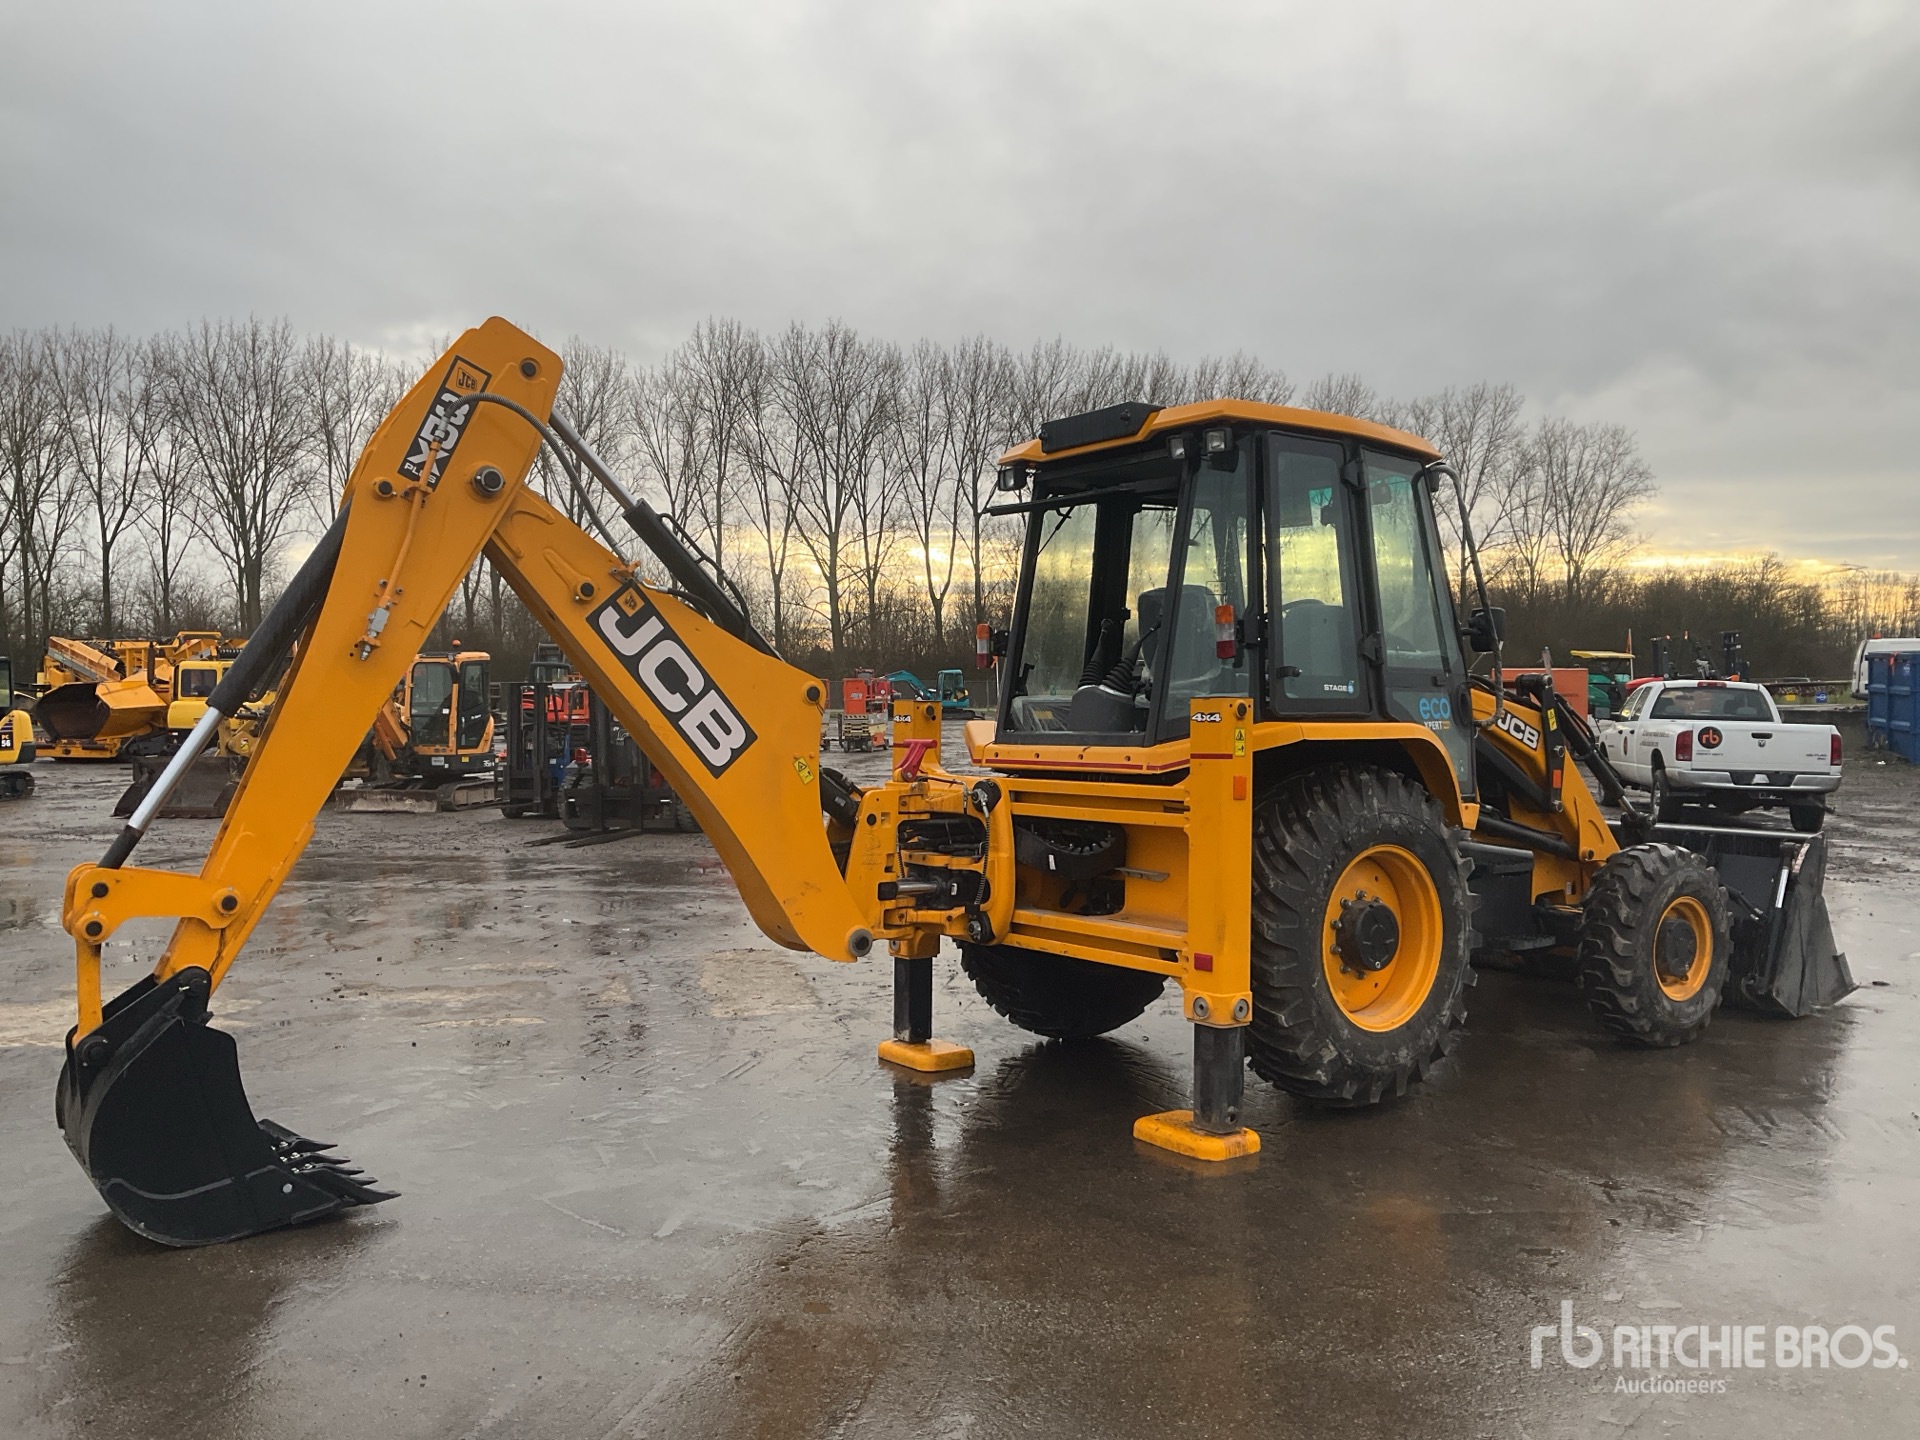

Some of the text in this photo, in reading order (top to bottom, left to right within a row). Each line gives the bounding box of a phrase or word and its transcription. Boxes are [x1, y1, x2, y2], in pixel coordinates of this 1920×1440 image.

[458, 371, 476, 389] JCB
[599, 606, 746, 767] JCB
[1324, 684, 1347, 692] STAGE
[1419, 697, 1450, 719] eco
[1497, 713, 1539, 749] JCB
[1702, 729, 1720, 744] rb
